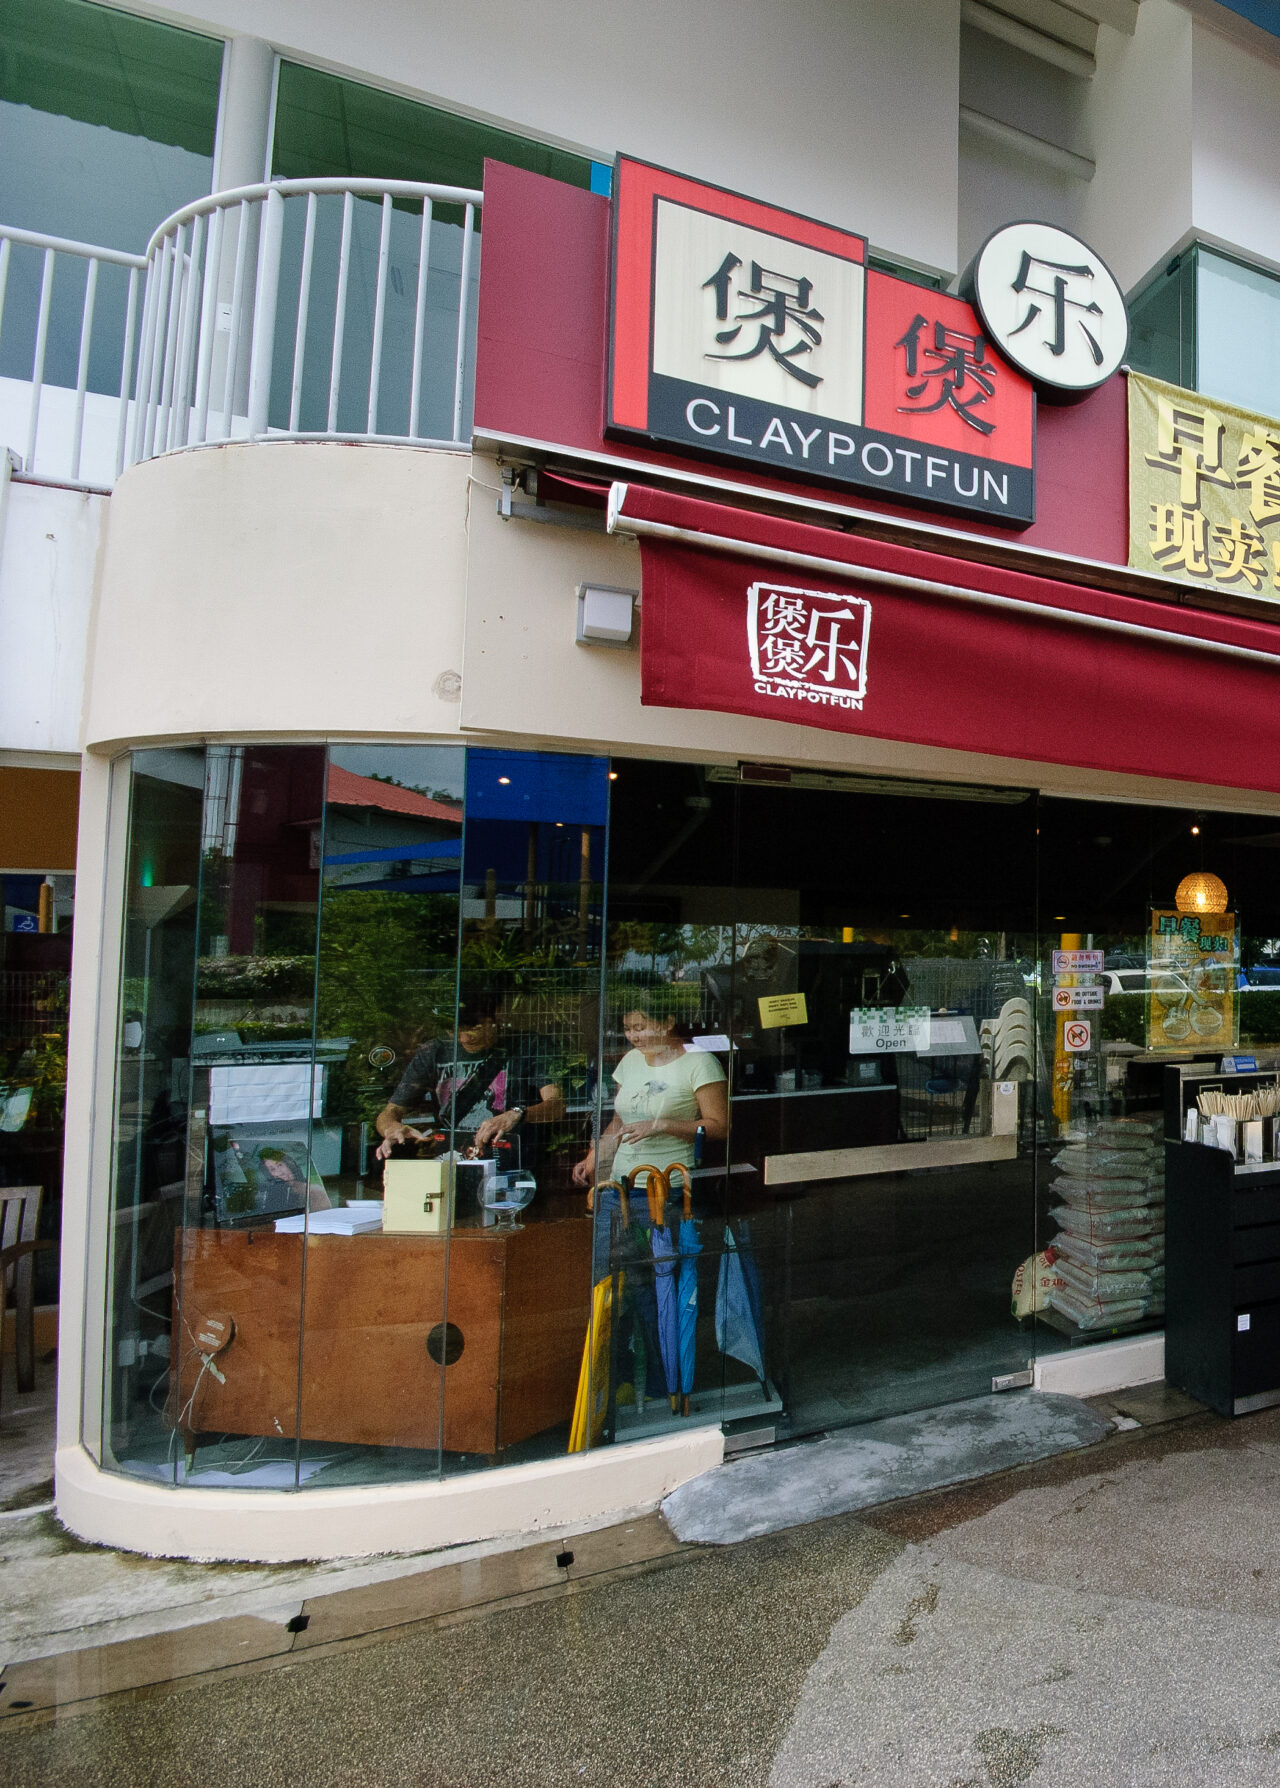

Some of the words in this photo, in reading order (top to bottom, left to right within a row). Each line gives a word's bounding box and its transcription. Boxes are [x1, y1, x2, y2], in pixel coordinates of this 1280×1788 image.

[686, 398, 1009, 505] CLAYPOTFUN
[754, 682, 864, 711] CLAYPOTFUN
[1157, 916, 1202, 943] 早餐
[876, 1038, 907, 1050] Open
